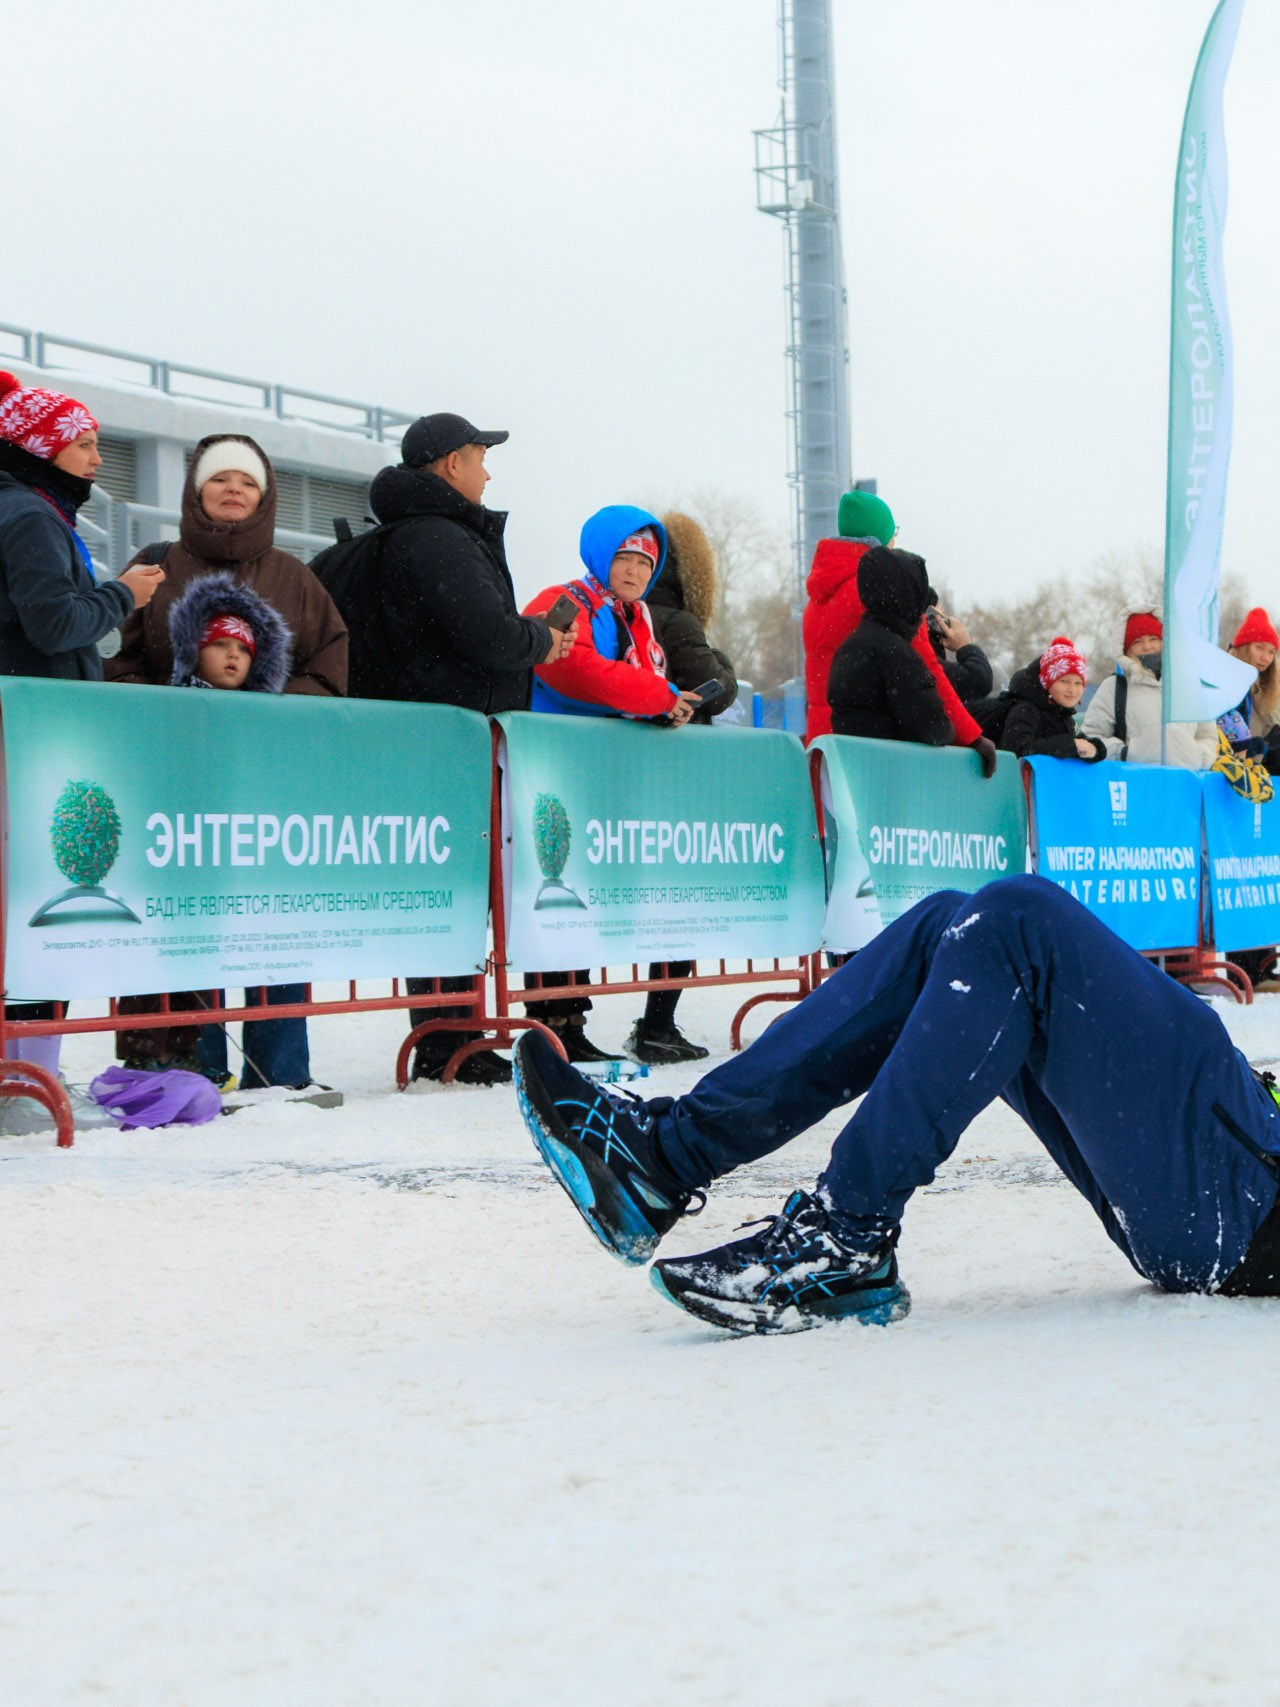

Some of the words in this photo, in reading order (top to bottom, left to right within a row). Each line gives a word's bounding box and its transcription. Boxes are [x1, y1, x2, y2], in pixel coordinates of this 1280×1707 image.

[145, 812, 451, 868] ЭНТЕРОЛАКТИС
[585, 819, 785, 865] ЭНТЕРОЛАКТИС
[869, 825, 1008, 871] ЭНТЕРОЛАКТИС
[1046, 846, 1095, 871] WINTER
[199, 895, 269, 916] ЯВЛЯЕТСЯ
[272, 892, 380, 914] ЛЕКАРСТВЕННЫМ
[382, 890, 453, 913] СРЕДСТВОМ
[621, 887, 667, 904] ЯВЛЯЕТСЯ
[668, 886, 739, 904] ЛЕКАРСТВЕННЫМ
[741, 885, 788, 903] СРЕДСТВОМ
